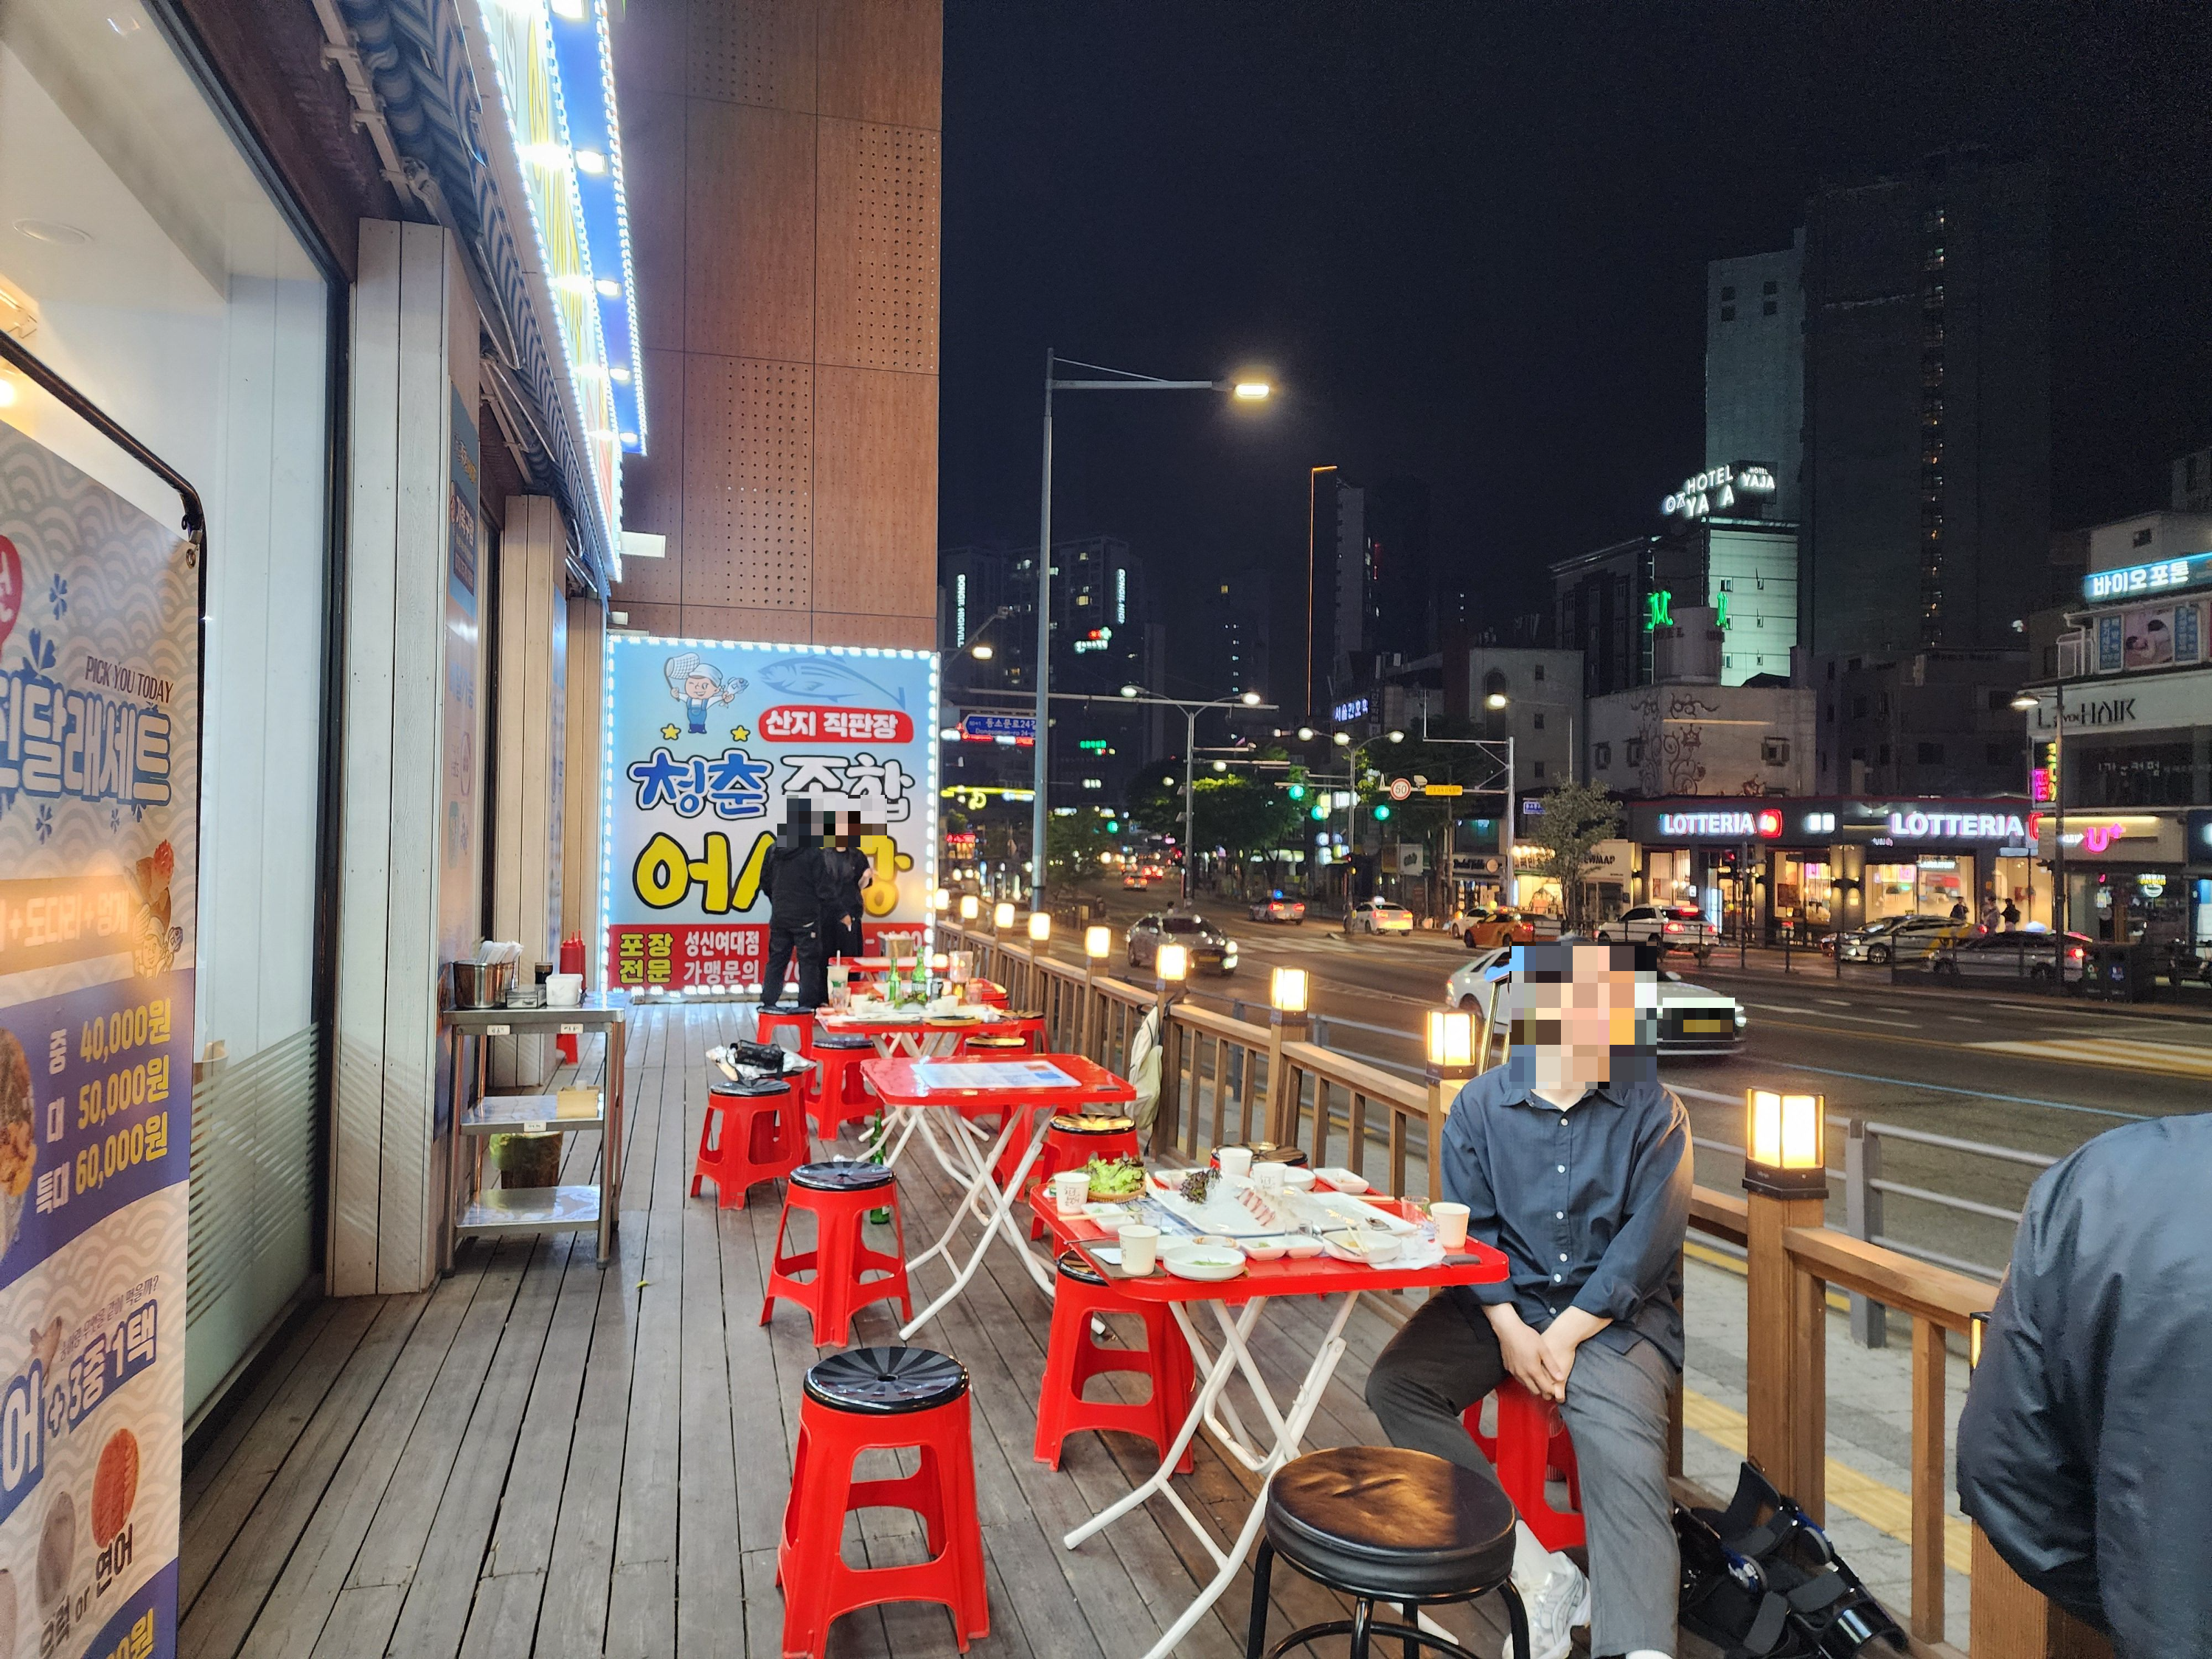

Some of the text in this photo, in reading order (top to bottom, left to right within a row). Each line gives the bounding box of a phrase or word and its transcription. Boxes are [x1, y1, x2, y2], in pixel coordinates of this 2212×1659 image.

[1687, 465, 1733, 495] HOTEL
[1742, 473, 1775, 489] YAJA
[1750, 467, 1768, 475] HOTEL
[1686, 484, 1734, 517] YAA
[85, 655, 173, 703] PICK YOU TODAY
[766, 711, 898, 739] 산지 직판장
[627, 748, 773, 820] 청춘
[1395, 785, 1407, 794] 50
[1663, 813, 1757, 834] LOTTERIA
[1892, 813, 2025, 835] LOTTERIA
[633, 831, 914, 917] 어장
[619, 933, 673, 958] 포장
[684, 931, 760, 957] 성신여대점
[619, 959, 673, 984] 전문
[684, 959, 759, 986] 가맹문의
[49, 997, 170, 1075] 중 40,000원
[46, 1054, 170, 1144] 대 50,000원
[36, 1111, 168, 1214] 특대 60,000원
[125, 1275, 159, 1306] 먹을까?
[75, 1586, 90, 1622] or
[96, 1523, 133, 1599] 연어
